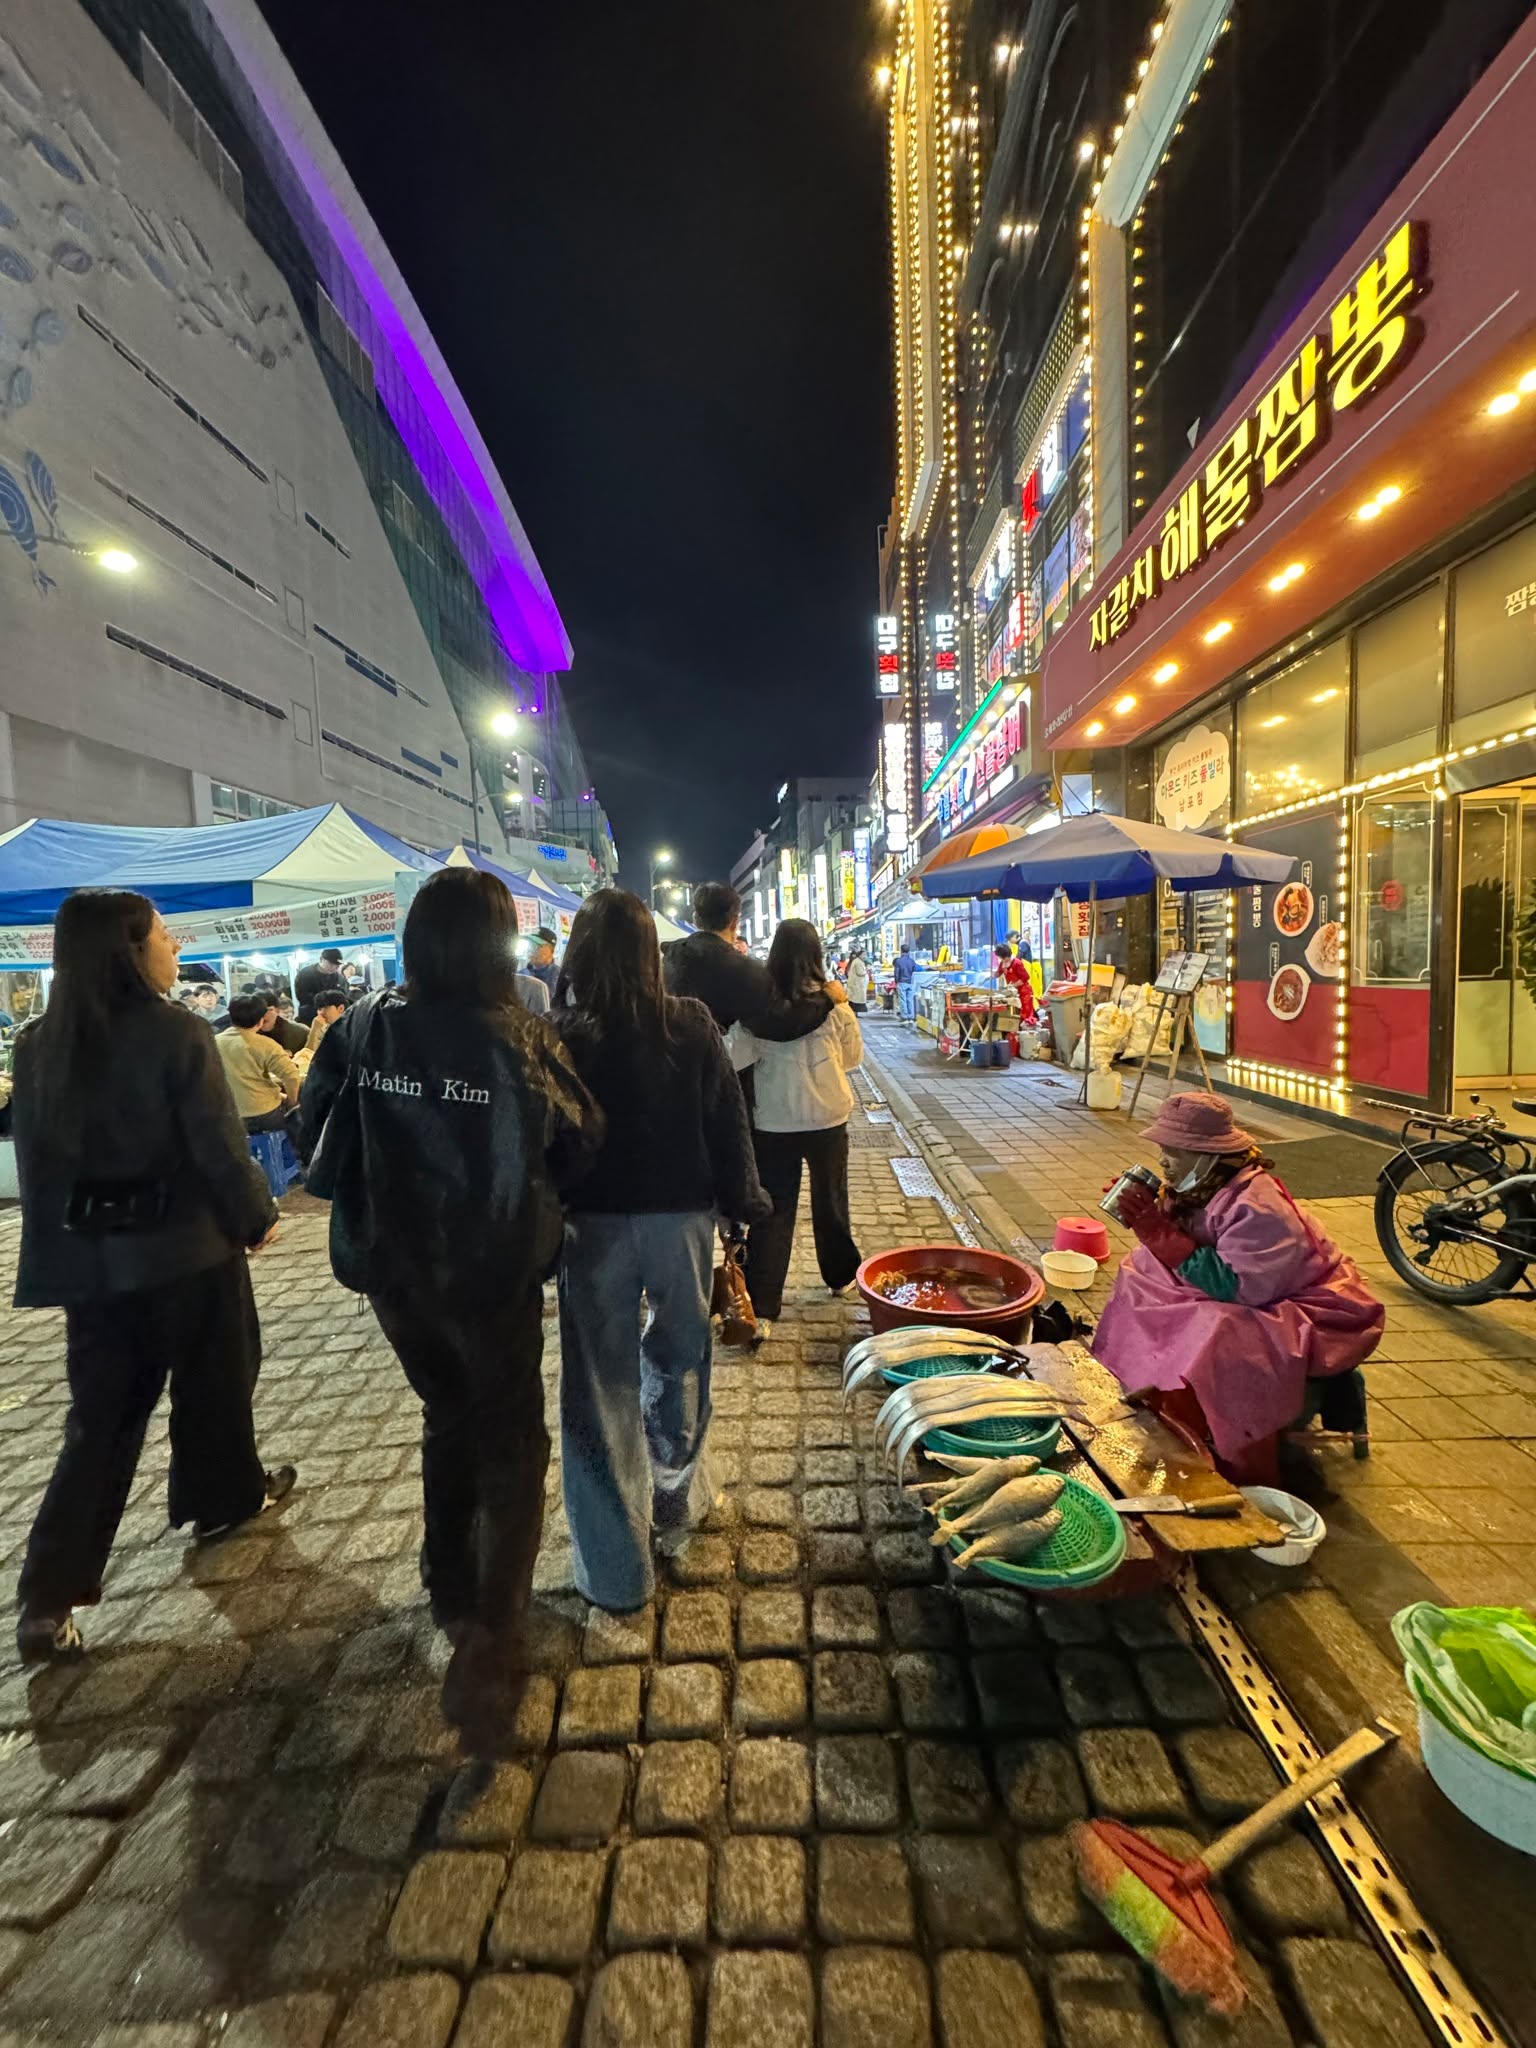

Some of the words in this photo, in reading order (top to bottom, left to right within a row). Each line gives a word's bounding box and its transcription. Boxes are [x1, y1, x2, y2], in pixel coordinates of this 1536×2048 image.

[1089, 545, 1153, 652] 자갈치
[1160, 220, 1414, 582] 해물짬뽕
[1161, 777, 1181, 799] 아몬드
[1183, 769, 1198, 789] 키즈
[1200, 755, 1224, 784] 풀빌라
[358, 1067, 422, 1097] Matin
[441, 1079, 490, 1104] Kim
